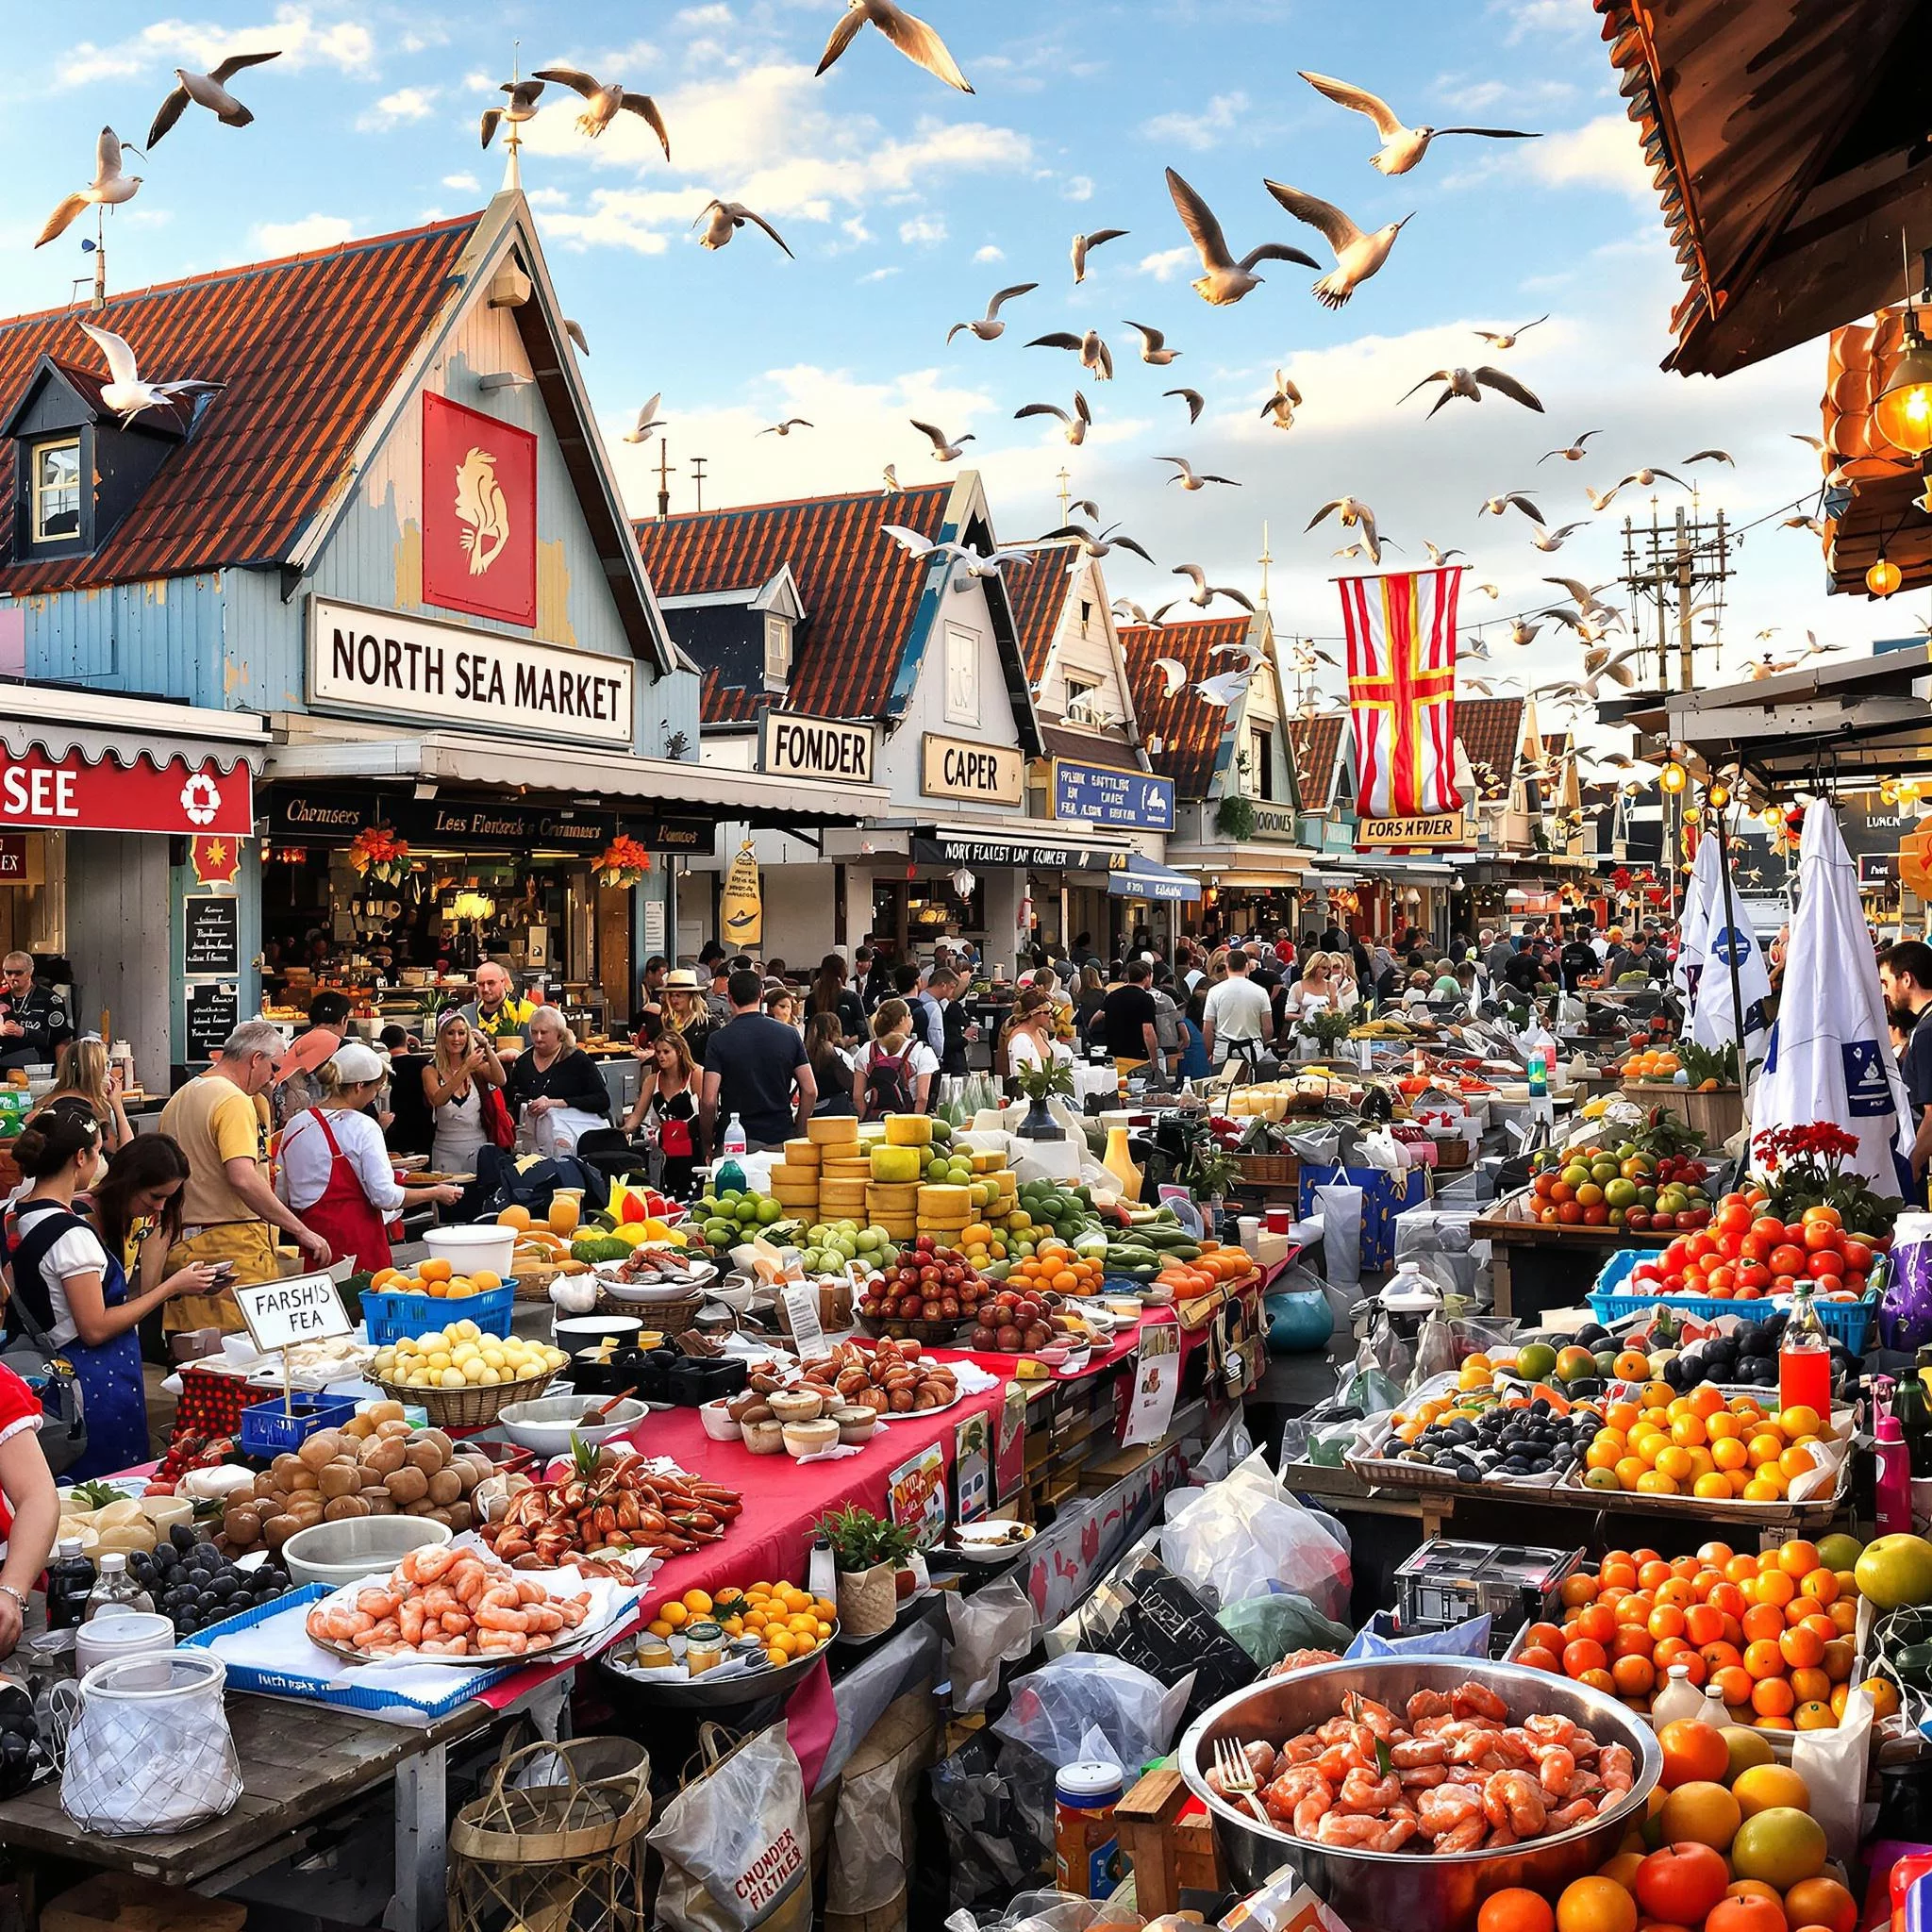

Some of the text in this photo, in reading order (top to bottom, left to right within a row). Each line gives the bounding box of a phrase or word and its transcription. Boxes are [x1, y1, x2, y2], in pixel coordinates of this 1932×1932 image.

[333, 628, 622, 722] NORTH SEA MARKET
[3, 766, 79, 817] SEE
[944, 748, 998, 791] CAPER
[289, 1310, 324, 1332] FEA
